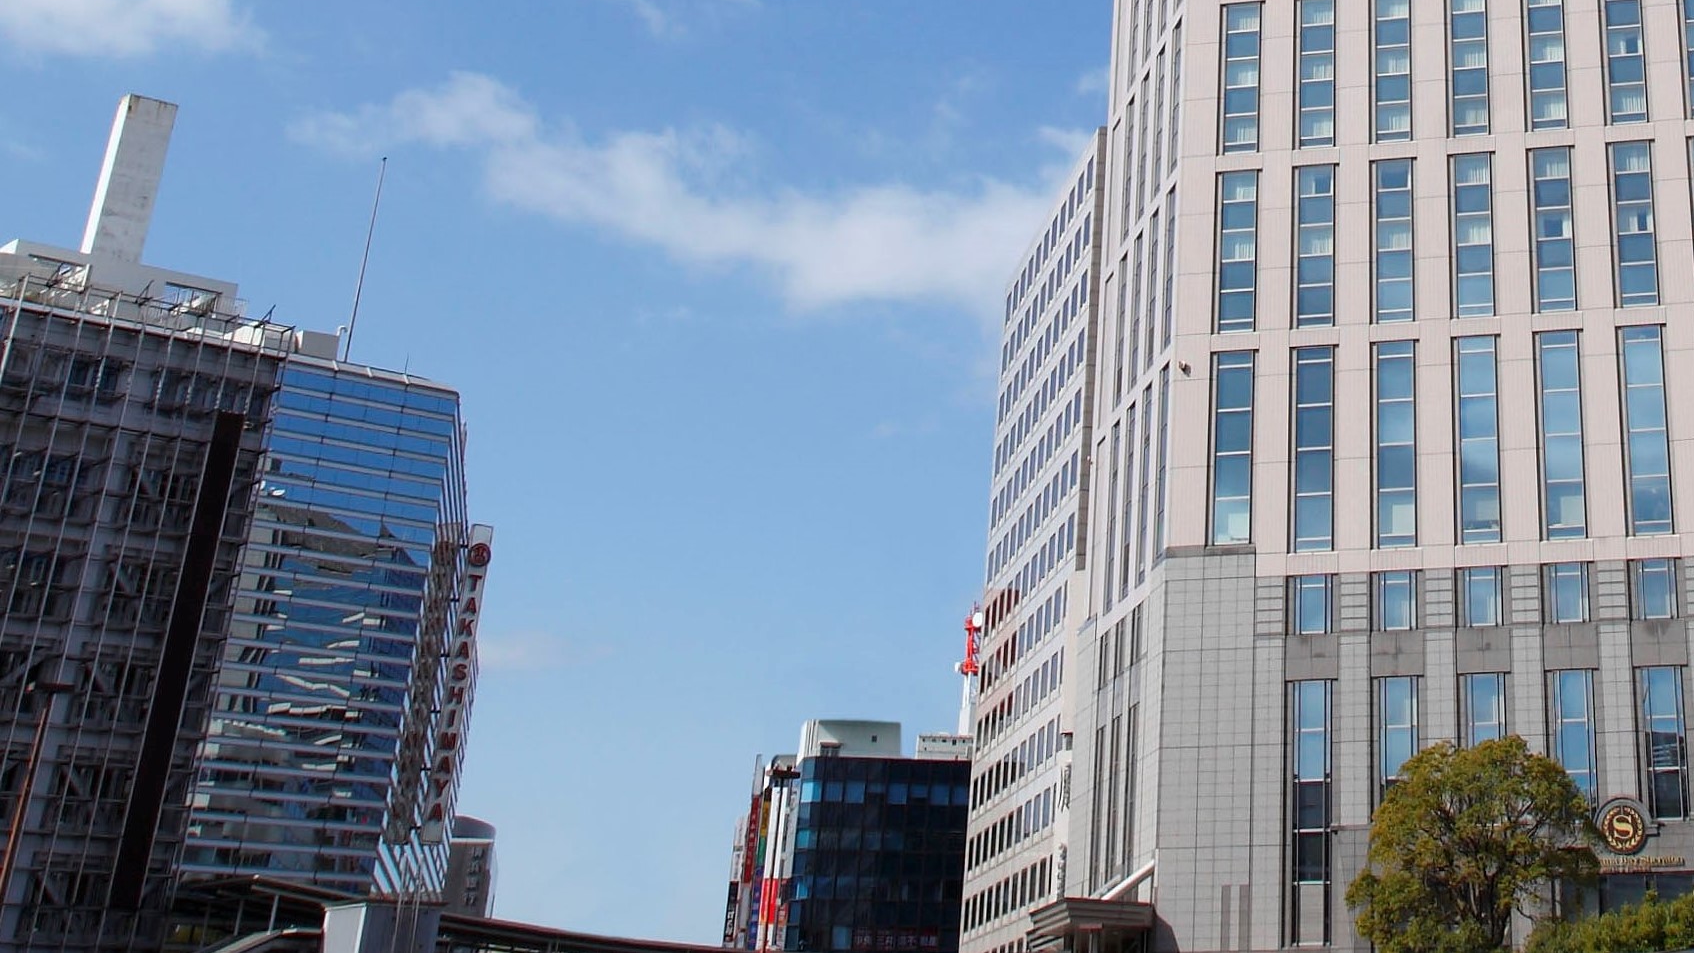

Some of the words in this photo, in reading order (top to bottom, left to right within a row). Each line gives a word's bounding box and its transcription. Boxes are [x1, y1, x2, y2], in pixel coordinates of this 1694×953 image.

[428, 573, 483, 822] TAKASHIMAYA
[1613, 814, 1634, 839] S
[1640, 855, 1684, 865] Sheraton
